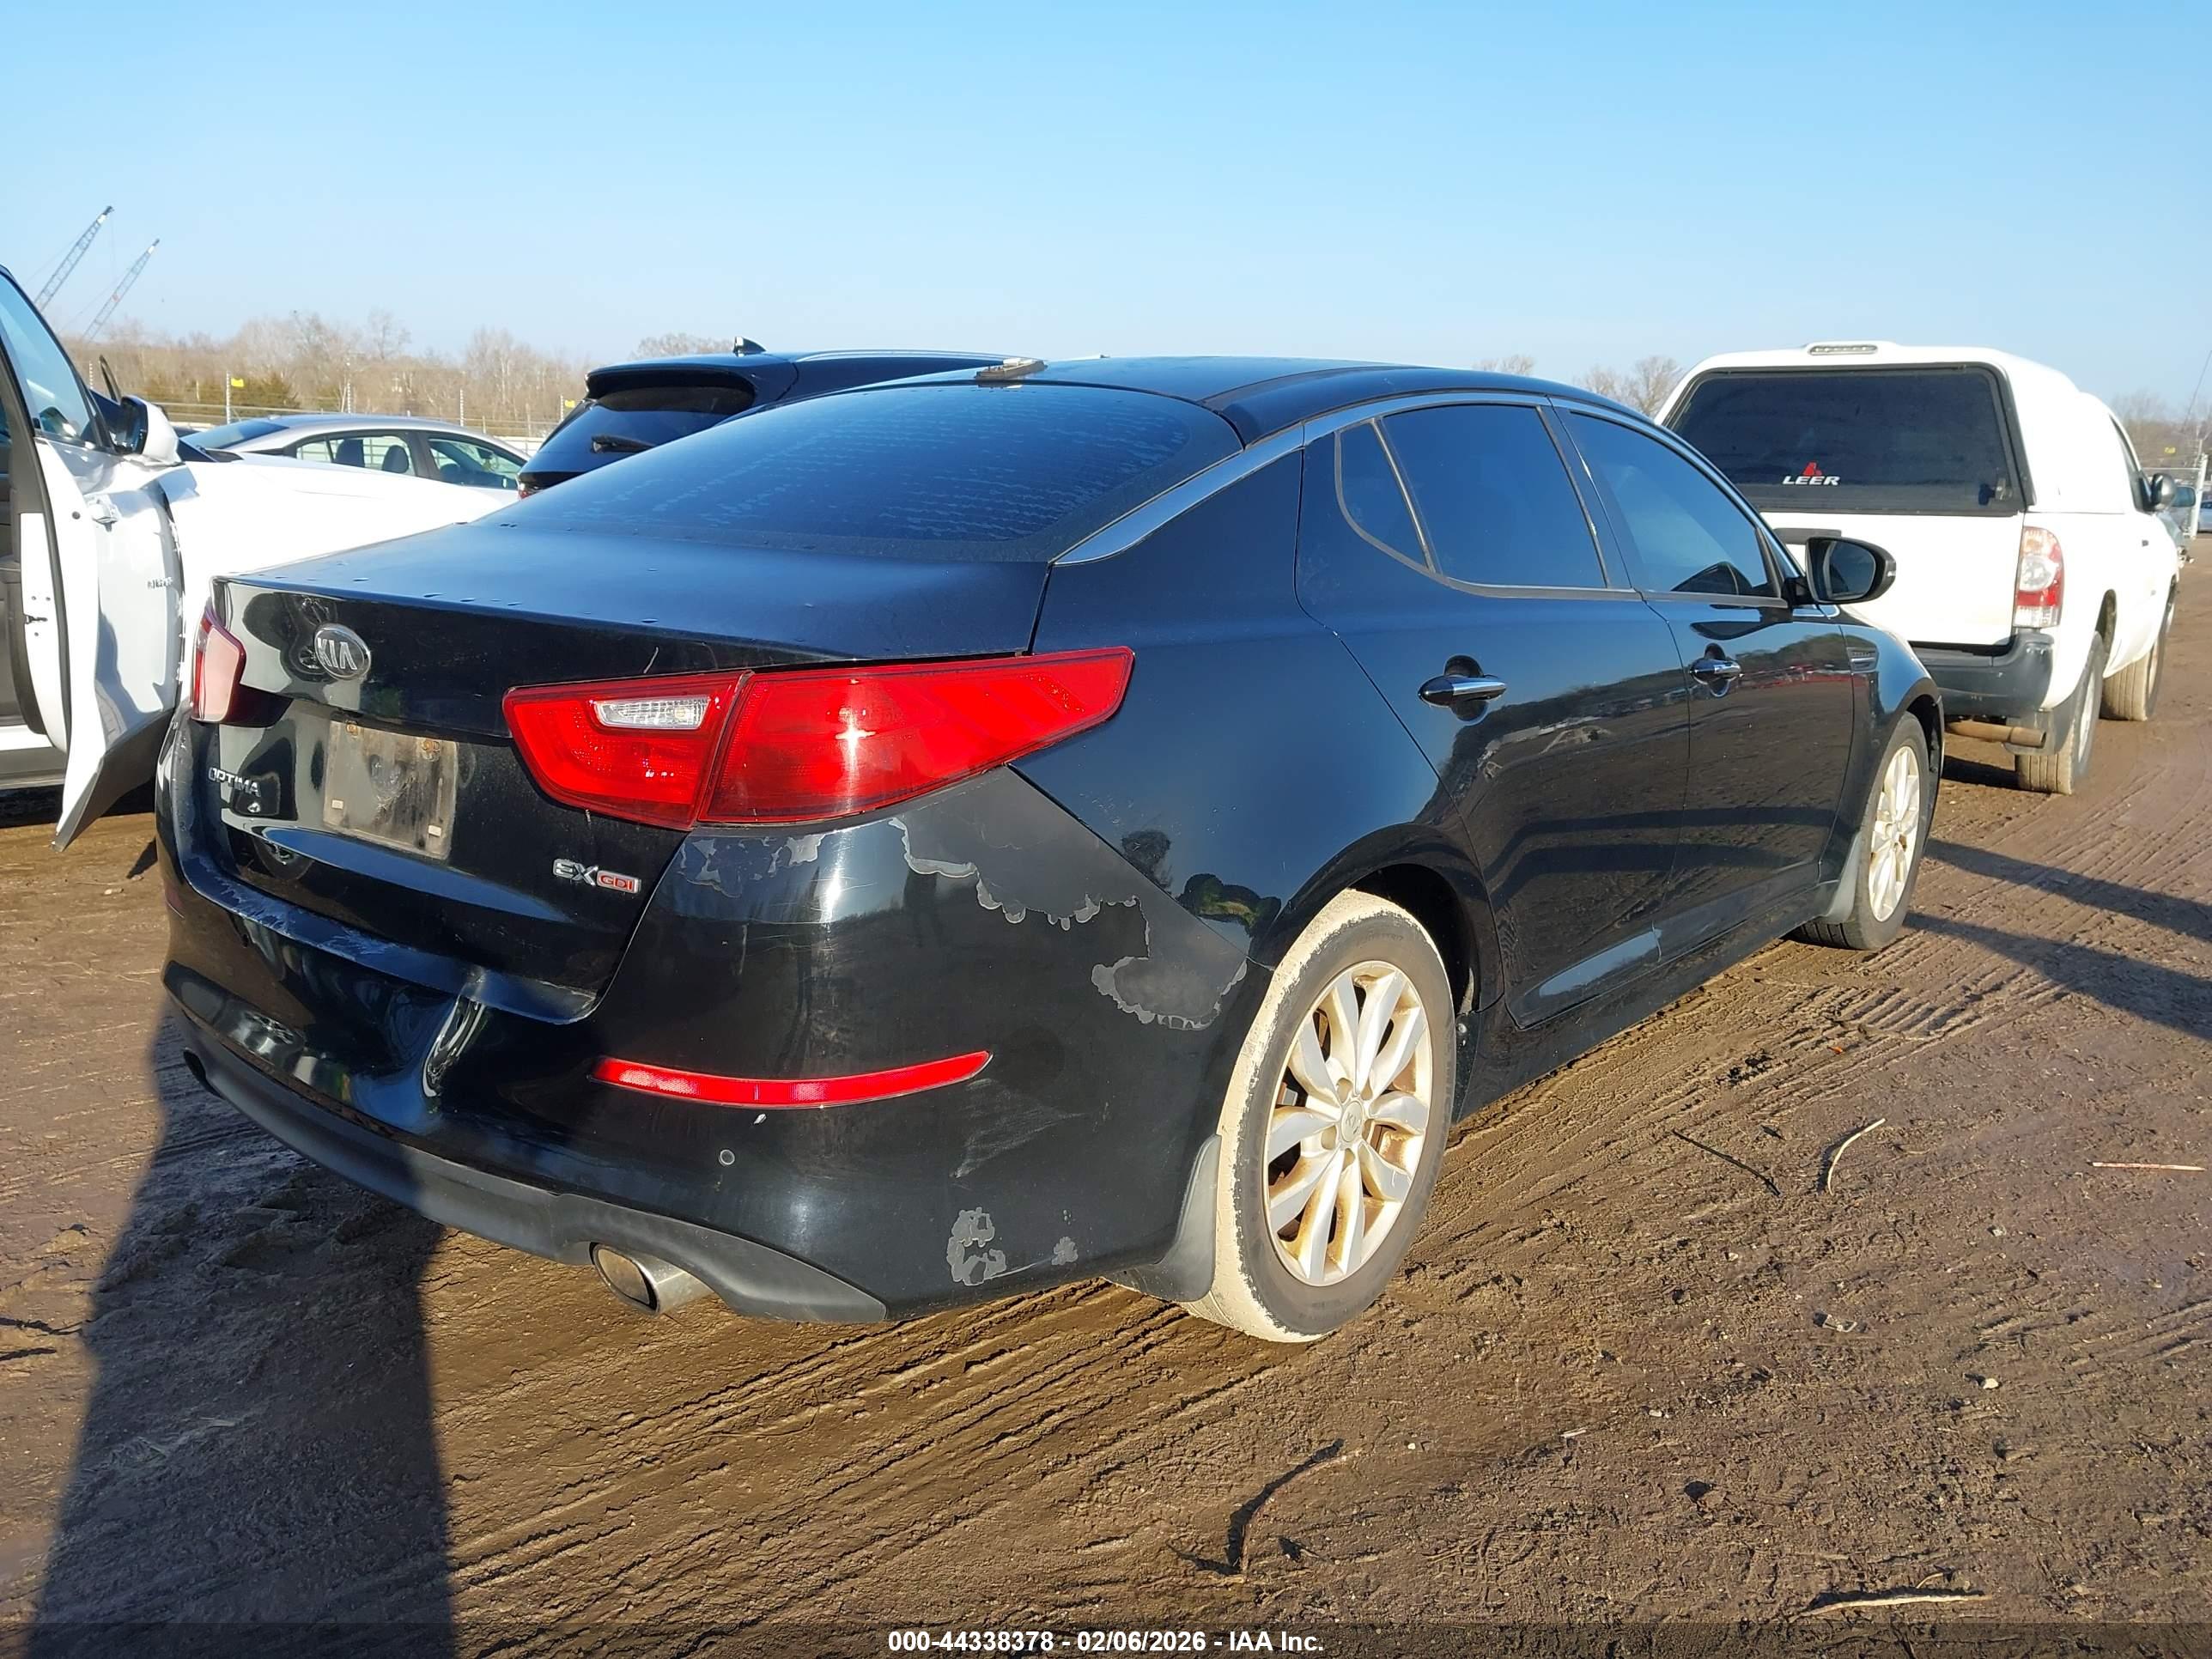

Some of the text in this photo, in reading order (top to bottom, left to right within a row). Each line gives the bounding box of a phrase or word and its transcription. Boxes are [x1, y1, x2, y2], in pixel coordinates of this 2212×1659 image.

[1782, 476, 1840, 485] LEER
[317, 637, 358, 670] KIA
[208, 766, 262, 798] OPTIMA
[552, 858, 635, 891] EX GDI
